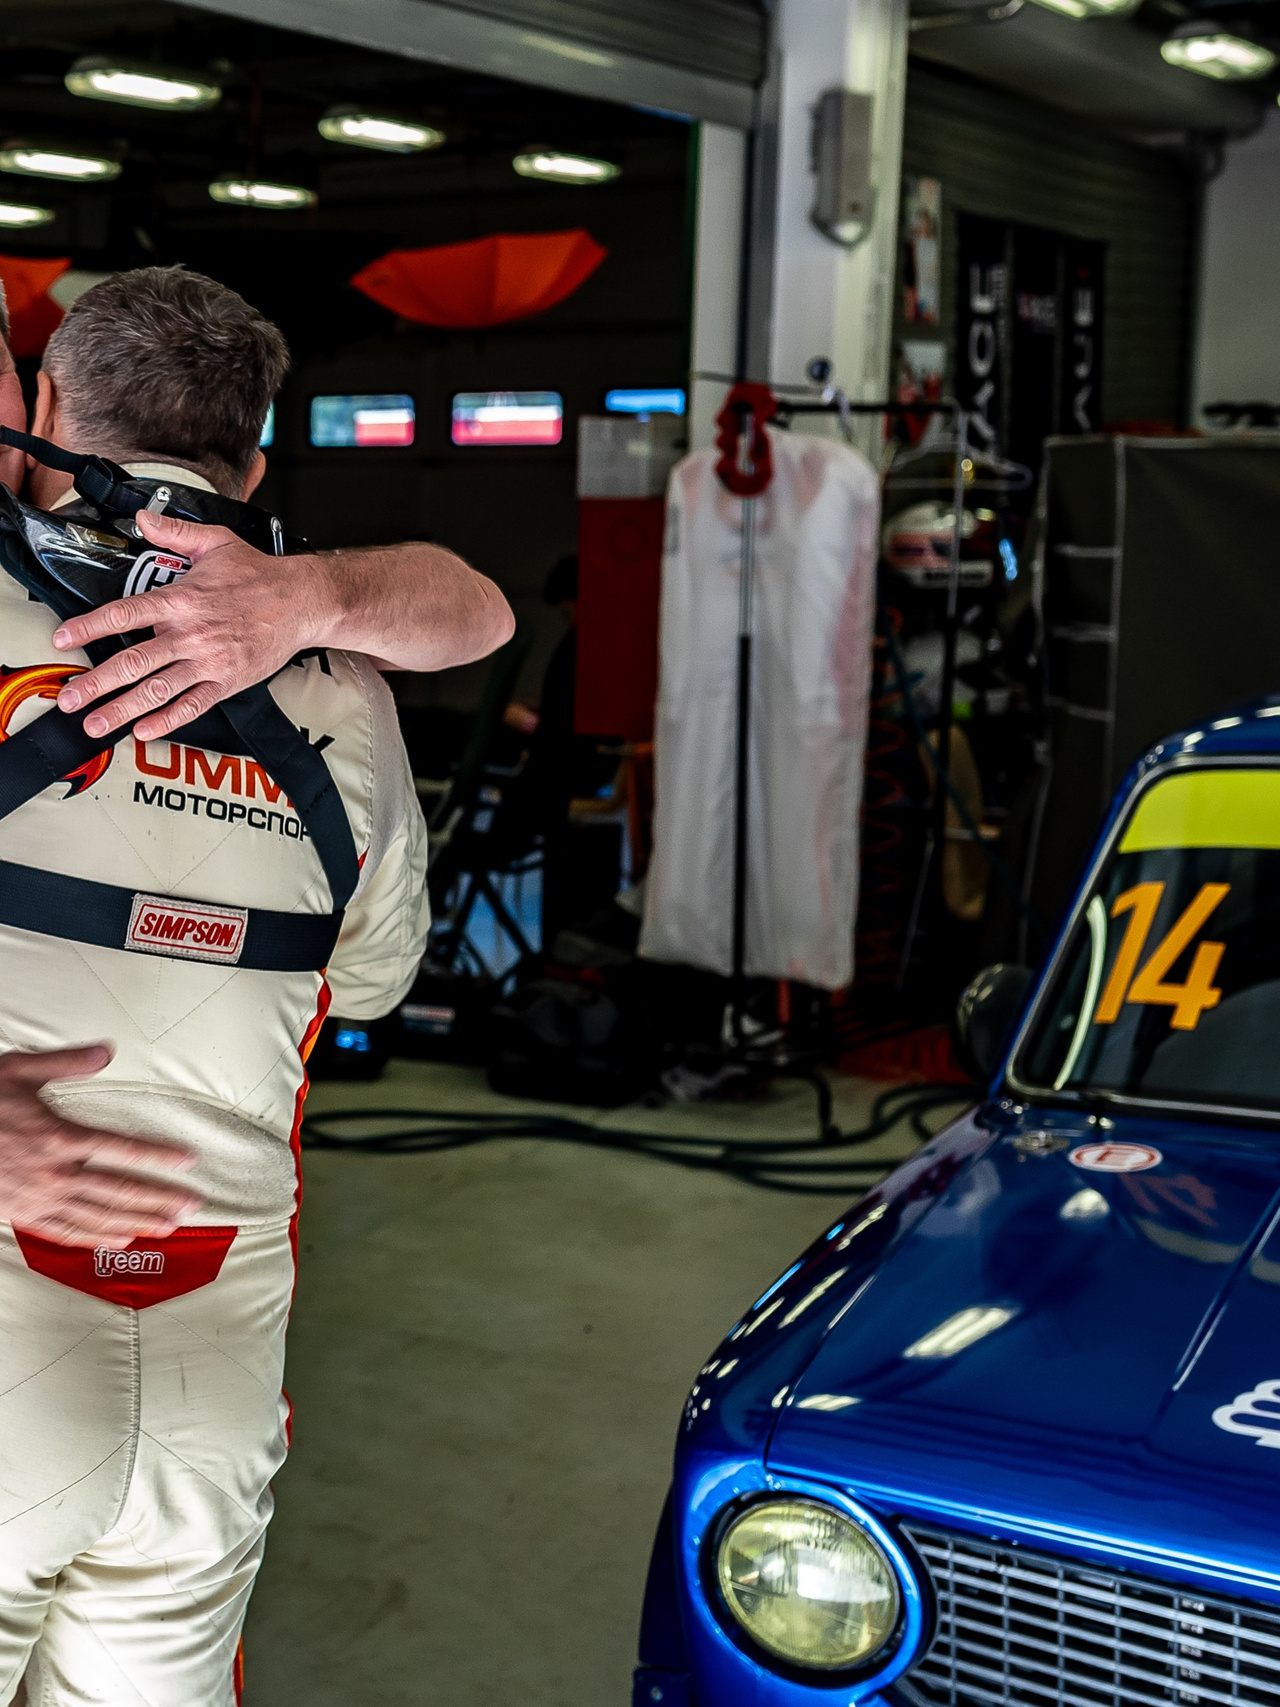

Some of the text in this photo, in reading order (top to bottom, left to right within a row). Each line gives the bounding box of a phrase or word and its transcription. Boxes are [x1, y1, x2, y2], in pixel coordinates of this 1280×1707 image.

[139, 912, 236, 948] SIMPSON
[1093, 880, 1231, 1031] 14
[96, 1246, 162, 1272] freem
